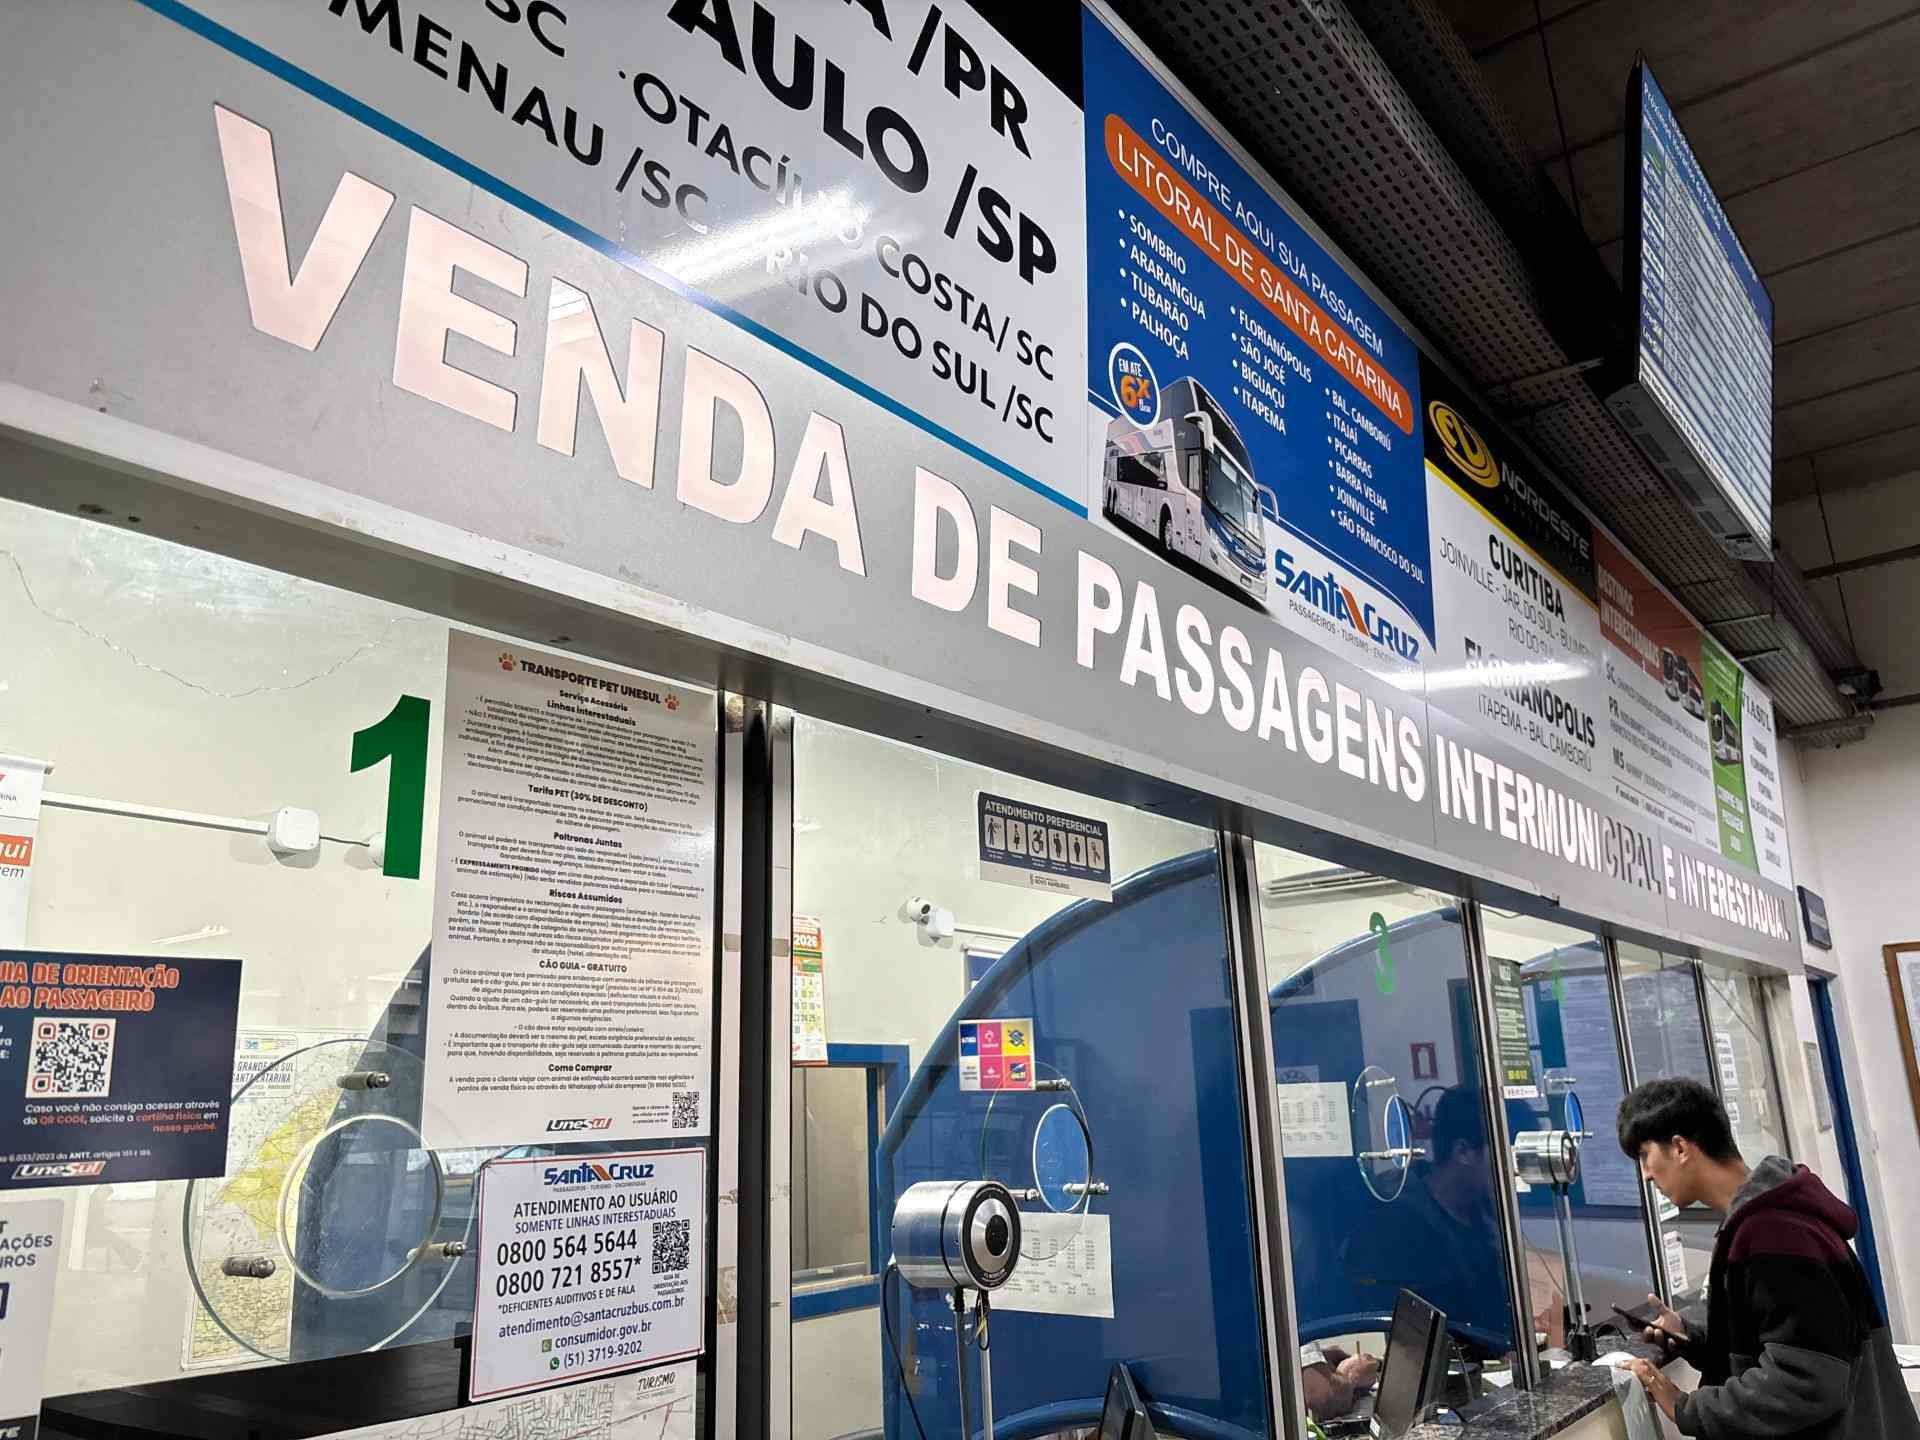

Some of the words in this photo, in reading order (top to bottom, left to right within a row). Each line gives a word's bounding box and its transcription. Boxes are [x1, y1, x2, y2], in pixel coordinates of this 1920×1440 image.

[943, 164, 1056, 285] /SP
[1151, 118, 1233, 212] COMPRE
[1235, 201, 1275, 253] AQUI
[1278, 241, 1310, 286] SUA
[1310, 272, 1383, 358] PASSAGEM
[1129, 214, 1187, 275] SOMBRIO
[1117, 133, 1221, 252] LITORAL
[1225, 233, 1255, 283] DE
[1260, 267, 1323, 346] SANTA
[1324, 328, 1403, 419] CATARINA
[1131, 271, 1189, 331] TUBARÃO
[1132, 301, 1189, 360] PALHOÇA
[1239, 309, 1312, 384] FLORIANÓPOLIS
[861, 292, 922, 359] DO
[932, 341, 996, 410] SUL
[1002, 385, 1054, 443] /SC
[1016, 330, 1054, 381] SC
[1240, 336, 1261, 365] SÃO
[1263, 357, 1286, 386] JOSÉ
[1241, 362, 1285, 409] BIGUAÇU
[1242, 389, 1287, 437] ITAPEMA
[1334, 437, 1373, 480] PIÇARRAS
[1335, 462, 1362, 495] BARRA
[1363, 485, 1388, 514] VELHA
[1336, 485, 1376, 527] JOINVILLE
[213, 102, 867, 577] VENDA
[911, 465, 1043, 648] DE
[1076, 549, 1426, 802] PASSAGENS
[1436, 734, 1661, 894] INTERMUNICIPAL
[1662, 844, 1677, 900] E
[1678, 853, 1792, 942] INTERESTADUAL
[1502, 461, 1590, 560] NORDESTE
[1337, 510, 1355, 534] SÃO
[1356, 524, 1398, 566] FRANCISCO
[1399, 554, 1410, 574] DO
[1410, 563, 1425, 585] SUL
[1440, 537, 1494, 594] JOINVILLE
[1489, 534, 1566, 622] CURITIBA
[1289, 599, 1336, 634] PASSAGEIROS
[1509, 618, 1525, 645] RIO
[520, 660, 598, 689] TRANSPORTE
[599, 678, 619, 693] PET
[620, 683, 661, 704] UNESUL
[559, 689, 589, 704] Serviço
[547, 699, 576, 713] Linhas
[1478, 694, 1522, 734] ITAPEMA
[350, 694, 431, 880] 1
[528, 784, 554, 796] Tarifa
[554, 788, 570, 798] PET
[592, 794, 603, 804] DE
[603, 795, 648, 812] DESCONTO)
[985, 799, 1045, 822] ATENDIMENTO
[1046, 814, 1104, 836] PREFERENCIAL
[553, 831, 594, 846] Poltronas
[595, 835, 623, 848] Juntas
[549, 889, 577, 900] Riscos
[577, 892, 623, 904] Assumidos
[793, 935, 817, 947] 2026
[32, 962, 60, 985] DE
[63, 963, 181, 989] ORIENTAÇÃO
[539, 959, 559, 969] CÃO
[559, 961, 580, 971] GUIA
[587, 963, 628, 973] GRATUITO
[0, 985, 32, 1008] AO
[33, 987, 156, 1012] PASSAGEIRO
[548, 1063, 574, 1072] Como
[575, 1063, 613, 1074] Comprar
[23, 1115, 38, 1126] do
[89, 1113, 125, 1123] solicite
[135, 1111, 174, 1122] cartilha
[203, 1111, 219, 1120] em
[25, 1104, 55, 1114] Caso
[55, 1102, 81, 1113] você
[82, 1102, 102, 1113] não
[104, 1102, 144, 1114] consiga
[146, 1101, 183, 1111] acessar
[184, 1099, 220, 1110] através
[152, 1124, 182, 1133] nosso
[514, 1196, 606, 1219] ATENDIMENTO
[608, 1194, 626, 1209] AO
[629, 1188, 679, 1208] USUÁRIO
[515, 1217, 563, 1234] SOMENTE
[566, 1213, 600, 1229] LINHAS
[602, 1207, 676, 1226] INTERESTADUAIS
[497, 1239, 546, 1266] 0800
[552, 1233, 587, 1259] 564
[593, 1228, 637, 1254] 5644
[495, 1269, 544, 1297] 0800
[551, 1263, 583, 1289] 721
[554, 1290, 597, 1306] AUDITIVOS
[598, 1288, 604, 1299] E
[605, 1287, 616, 1298] DE
[617, 1285, 636, 1297] FALA
[498, 1296, 685, 1338] atendimento@santacruzbus.com.br
[555, 1318, 652, 1349] consumidor.gov.br
[563, 1350, 585, 1369] (51)
[587, 1340, 643, 1363] 3719-9202
[637, 1371, 676, 1390] TURISMO
